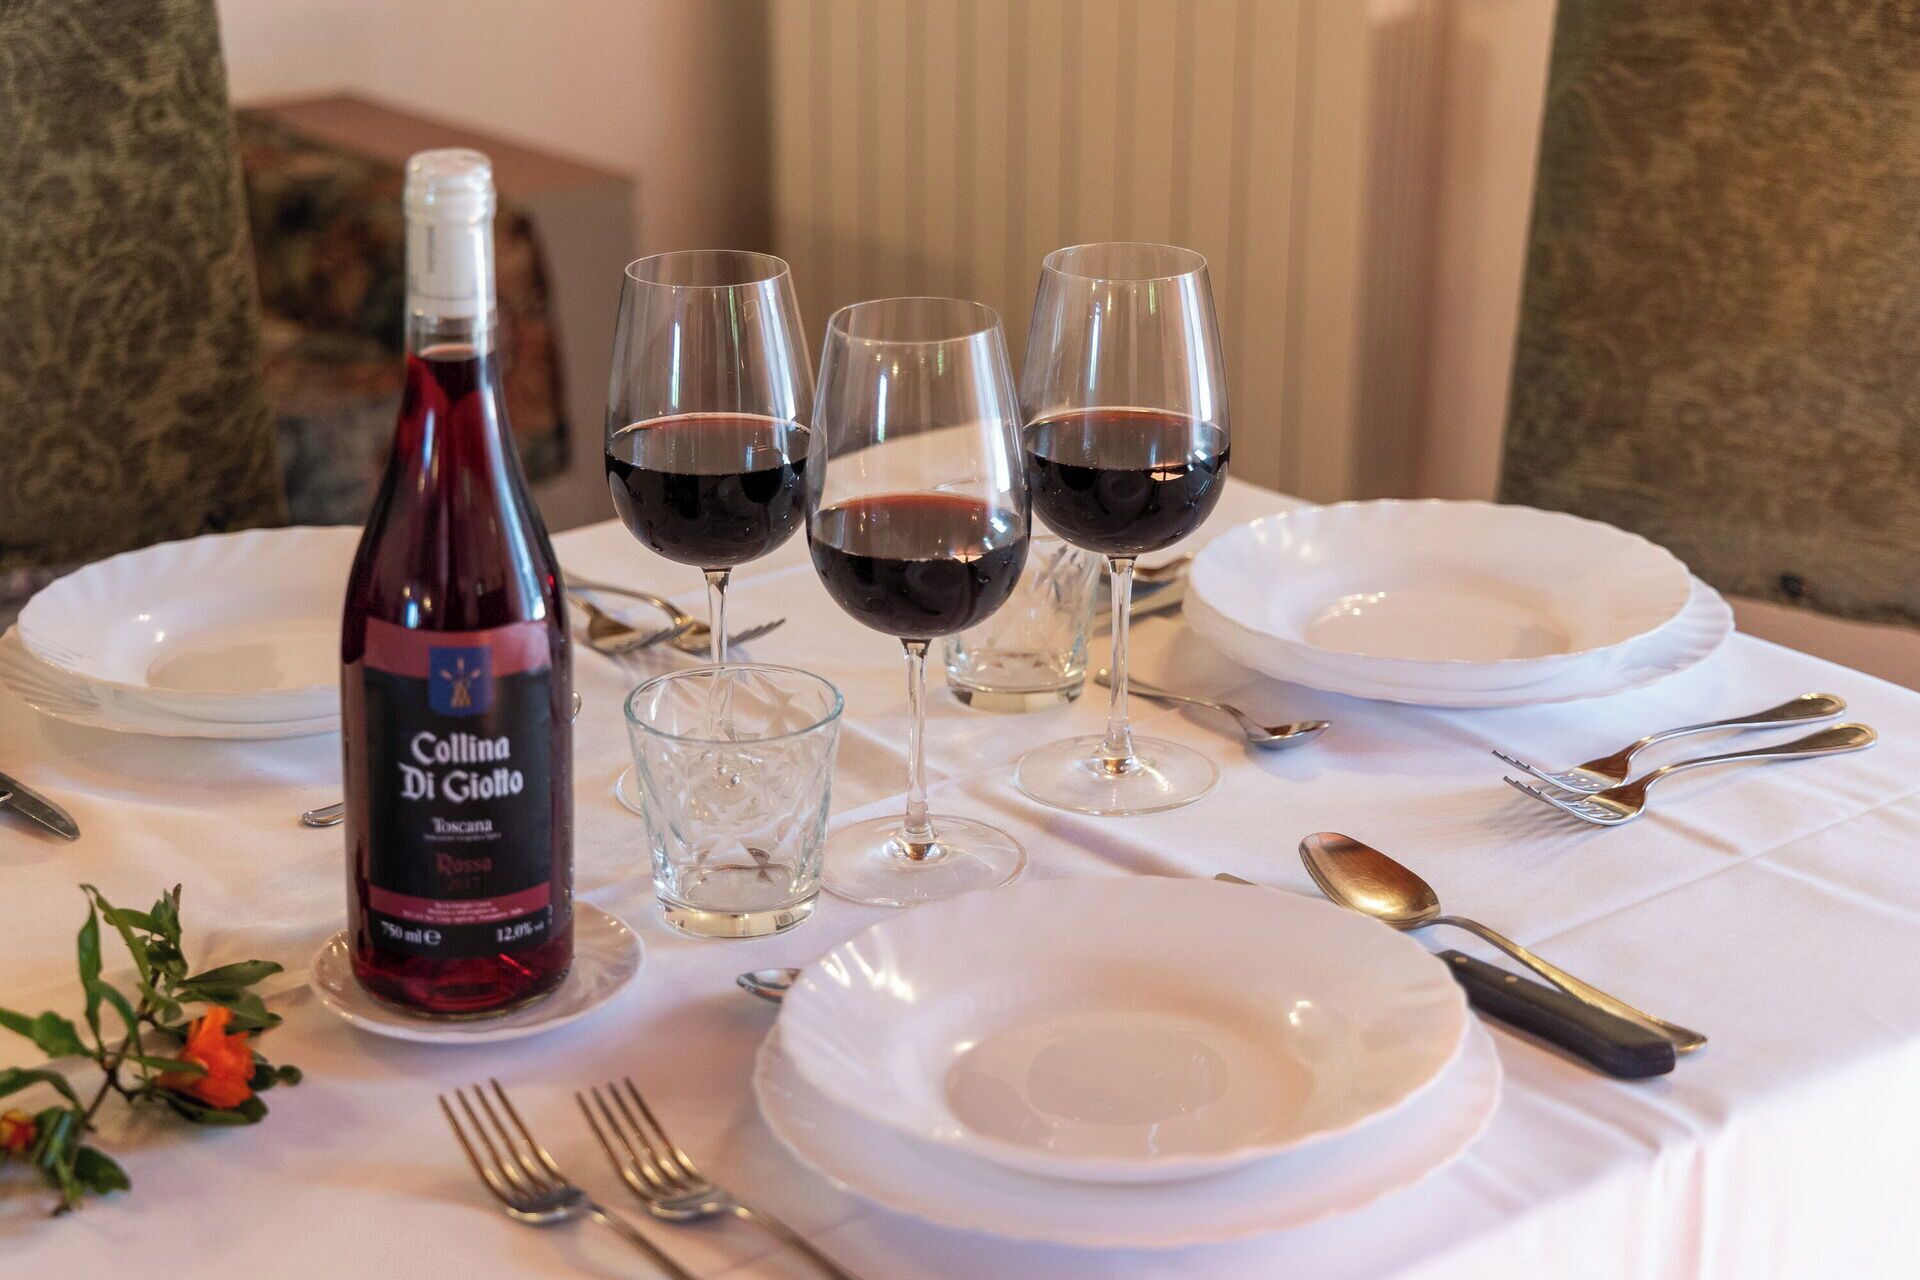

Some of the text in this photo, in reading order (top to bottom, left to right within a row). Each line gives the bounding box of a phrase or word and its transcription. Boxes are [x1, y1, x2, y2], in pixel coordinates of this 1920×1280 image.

[410, 731, 510, 765] Collina
[398, 761, 524, 803] Di Giotto
[431, 816, 493, 833] Toscana
[436, 853, 493, 876] Rosso
[380, 920, 403, 939] 750
[404, 928, 422, 944] ml
